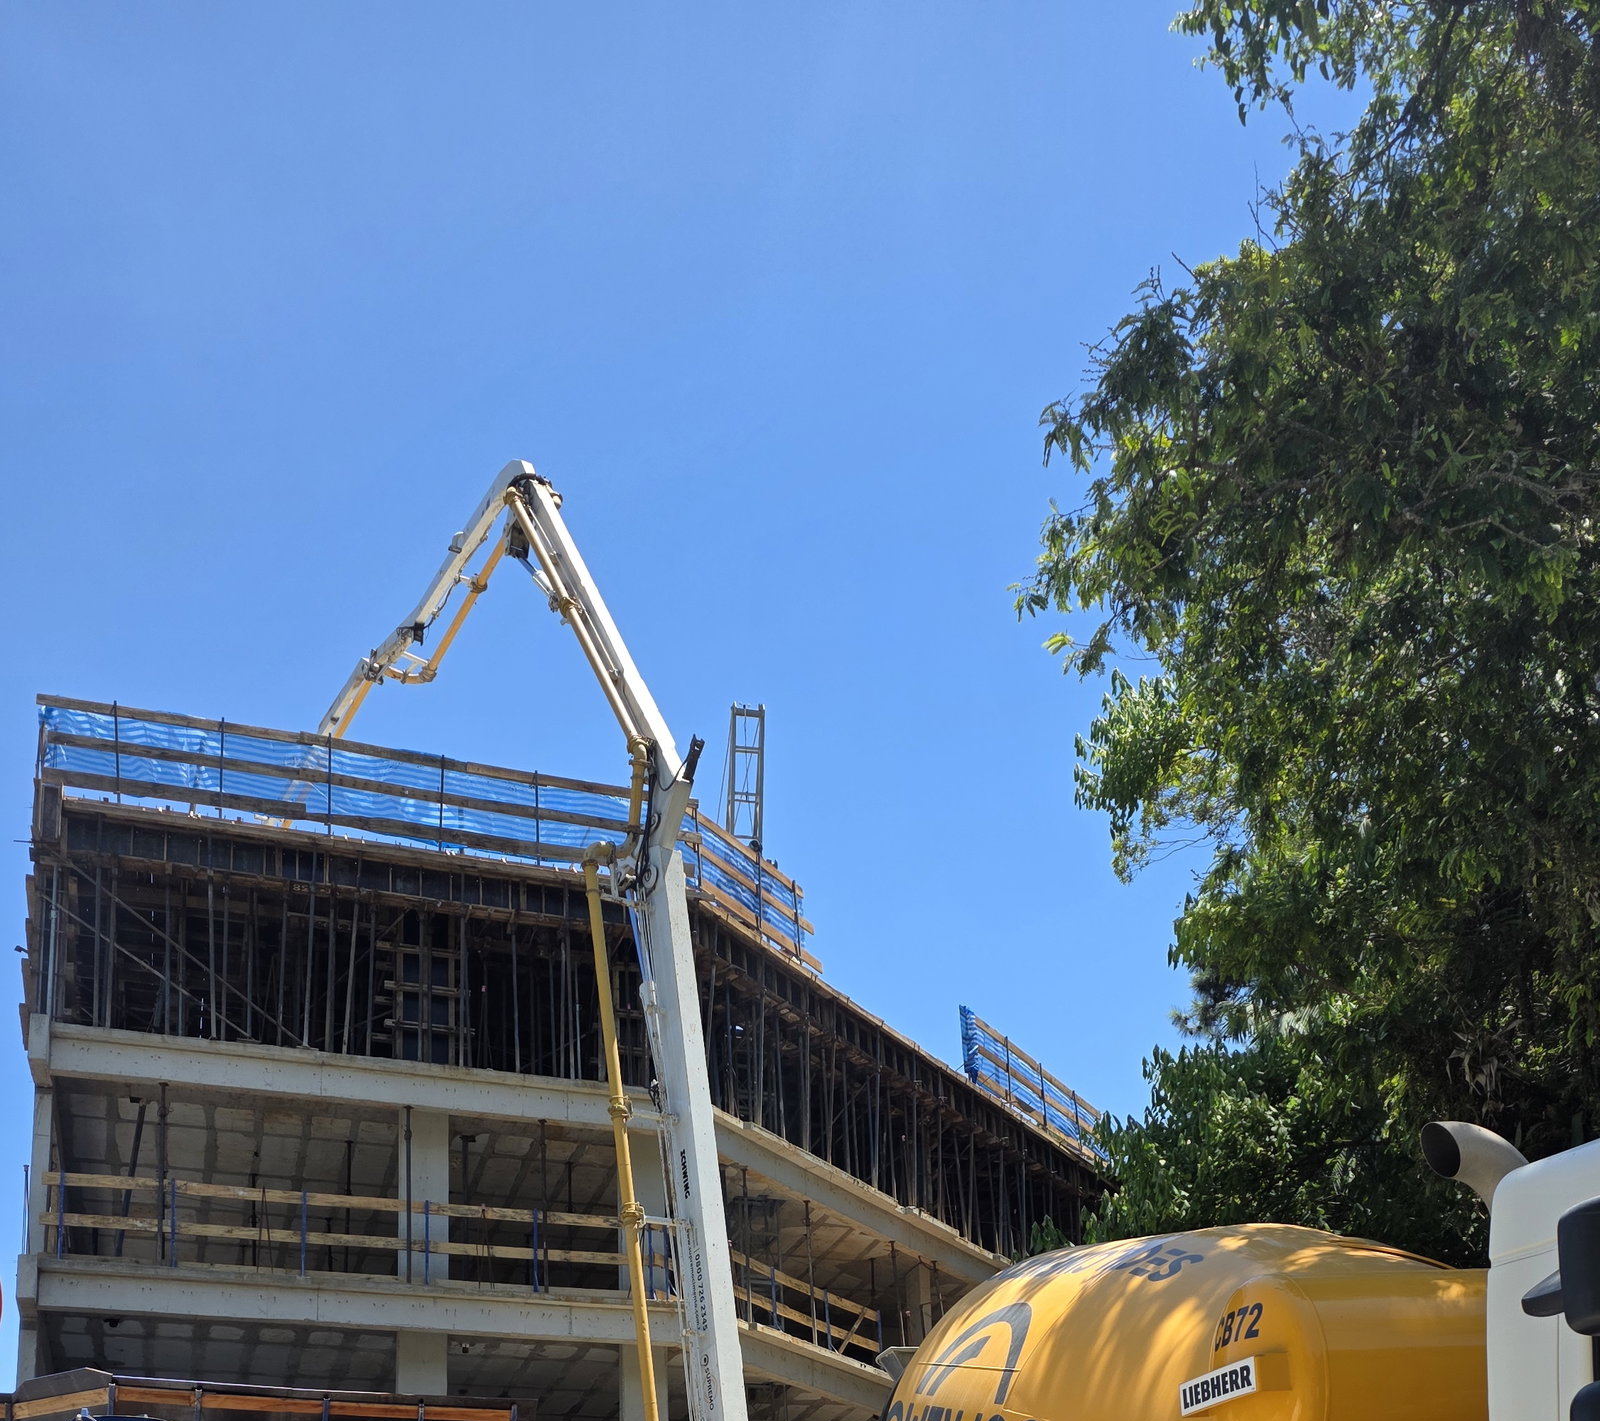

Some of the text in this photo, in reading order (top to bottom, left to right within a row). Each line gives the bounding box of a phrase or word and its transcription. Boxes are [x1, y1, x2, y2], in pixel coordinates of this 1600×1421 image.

[680, 1148, 690, 1200] SCHWING
[694, 1253, 703, 1282] 0800
[700, 1304, 708, 1332] 2345
[1214, 1302, 1263, 1353] CB72
[704, 1367, 714, 1411] SUPREMO
[1182, 1364, 1252, 1410] LIEBHERR
